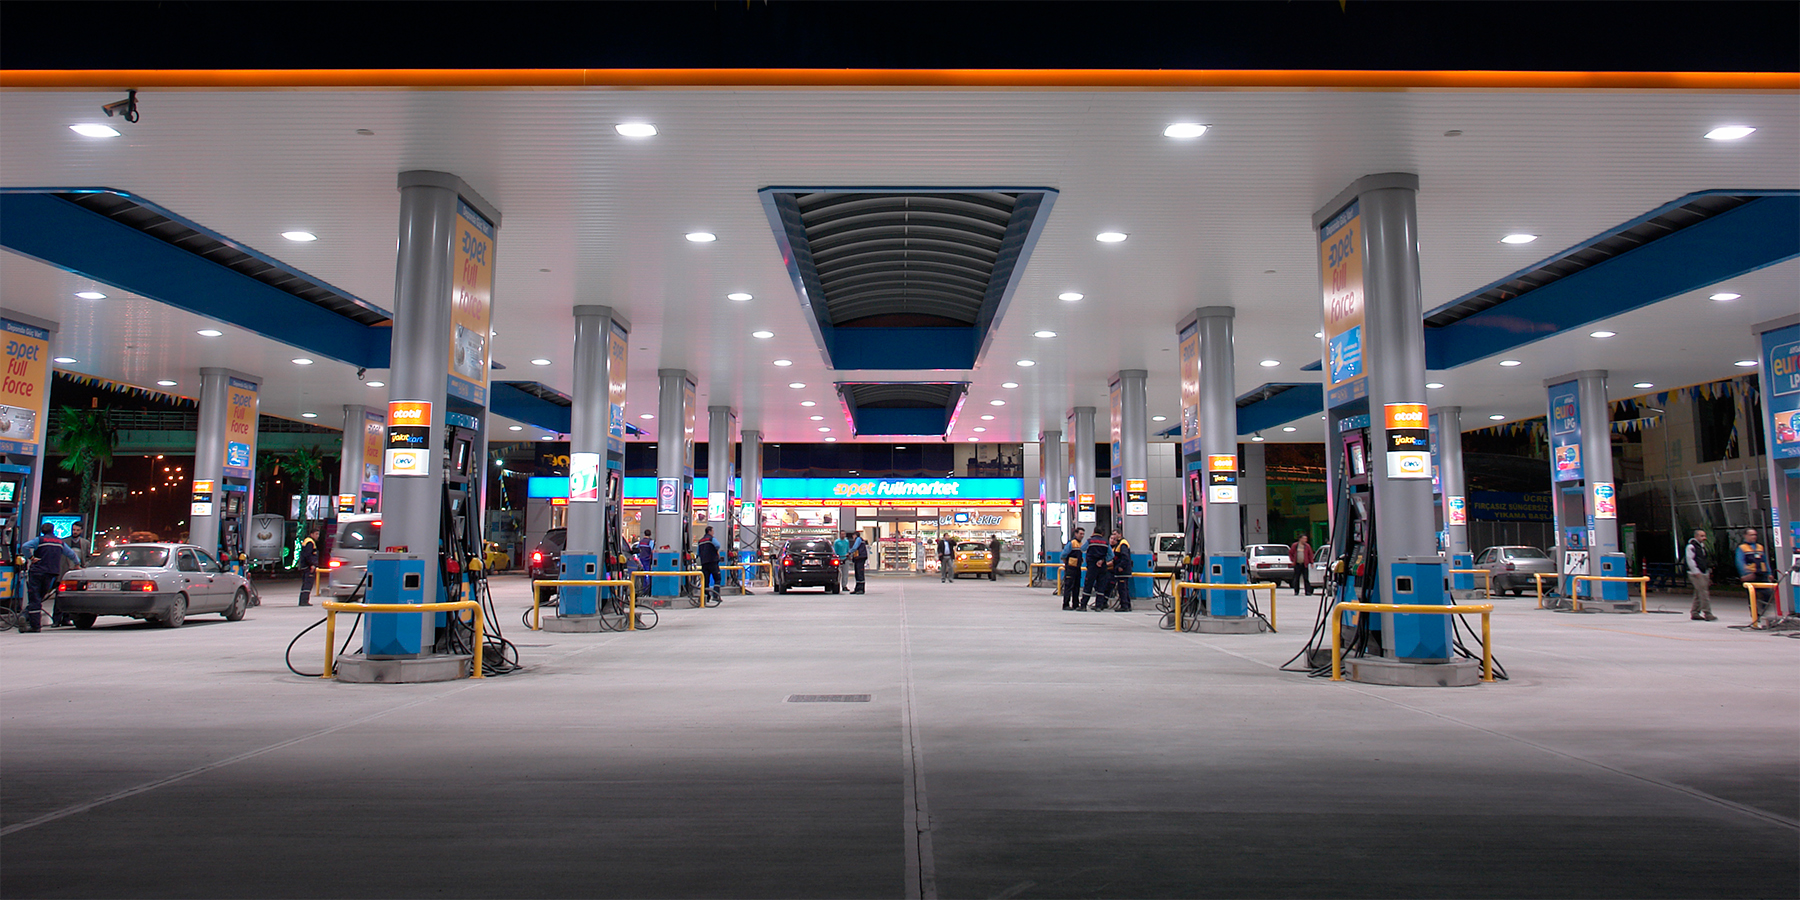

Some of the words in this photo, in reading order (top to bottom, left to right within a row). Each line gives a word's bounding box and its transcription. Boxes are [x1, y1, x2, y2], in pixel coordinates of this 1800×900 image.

[463, 258, 478, 288] full
[1332, 262, 1346, 294] full
[459, 285, 482, 320] force
[1330, 292, 1354, 324] force
[8, 358, 28, 376] full
[1774, 354, 1800, 376] eur
[2, 376, 34, 397] force
[234, 406, 245, 420] full
[394, 409, 422, 418] otobil
[1394, 412, 1422, 420] otobil
[1556, 404, 1574, 420] euro
[230, 420, 249, 434] force
[1564, 418, 1576, 429] LPG
[877, 481, 959, 495] fullmarket
[1474, 503, 1507, 511] FIRÇASIZ
